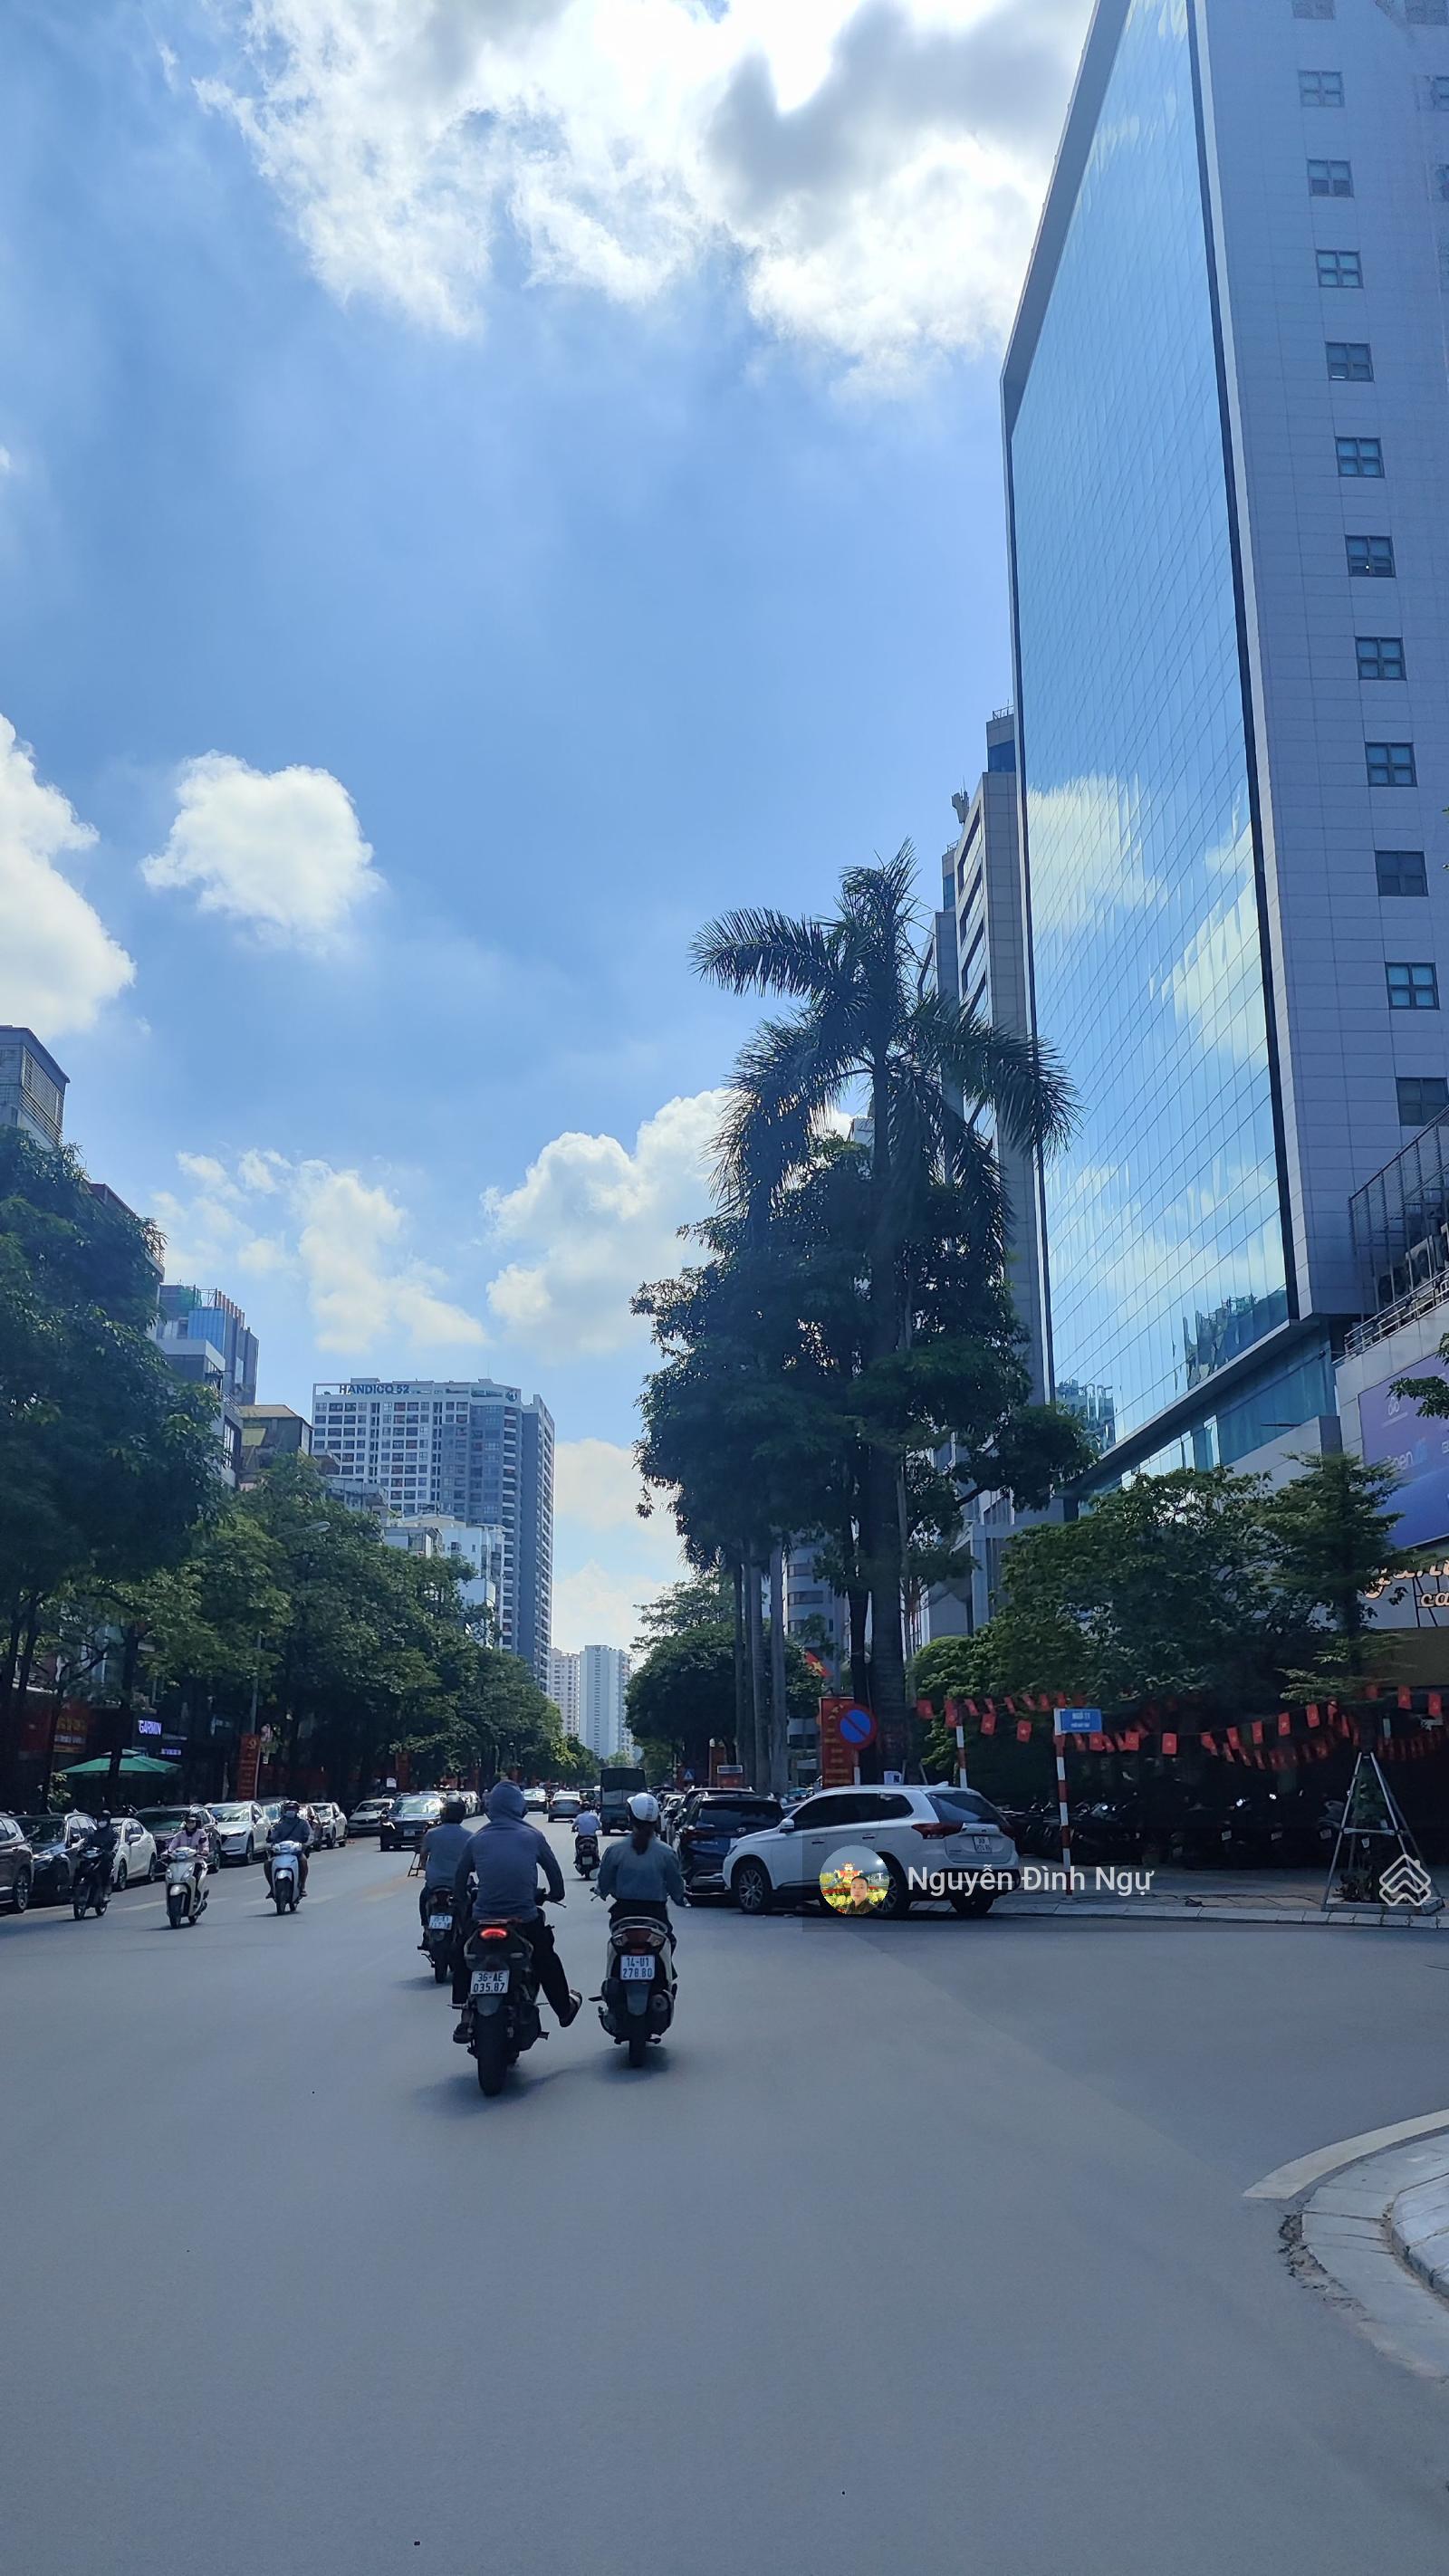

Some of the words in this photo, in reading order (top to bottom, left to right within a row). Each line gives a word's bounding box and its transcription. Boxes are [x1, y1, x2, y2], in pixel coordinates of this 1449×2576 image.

[339, 1384, 393, 1395] HANDICO
[396, 1384, 409, 1394] 52
[138, 1719, 162, 1735] GARMIN
[477, 1972, 504, 1982] 36-AE
[473, 1982, 505, 1993] 035.87
